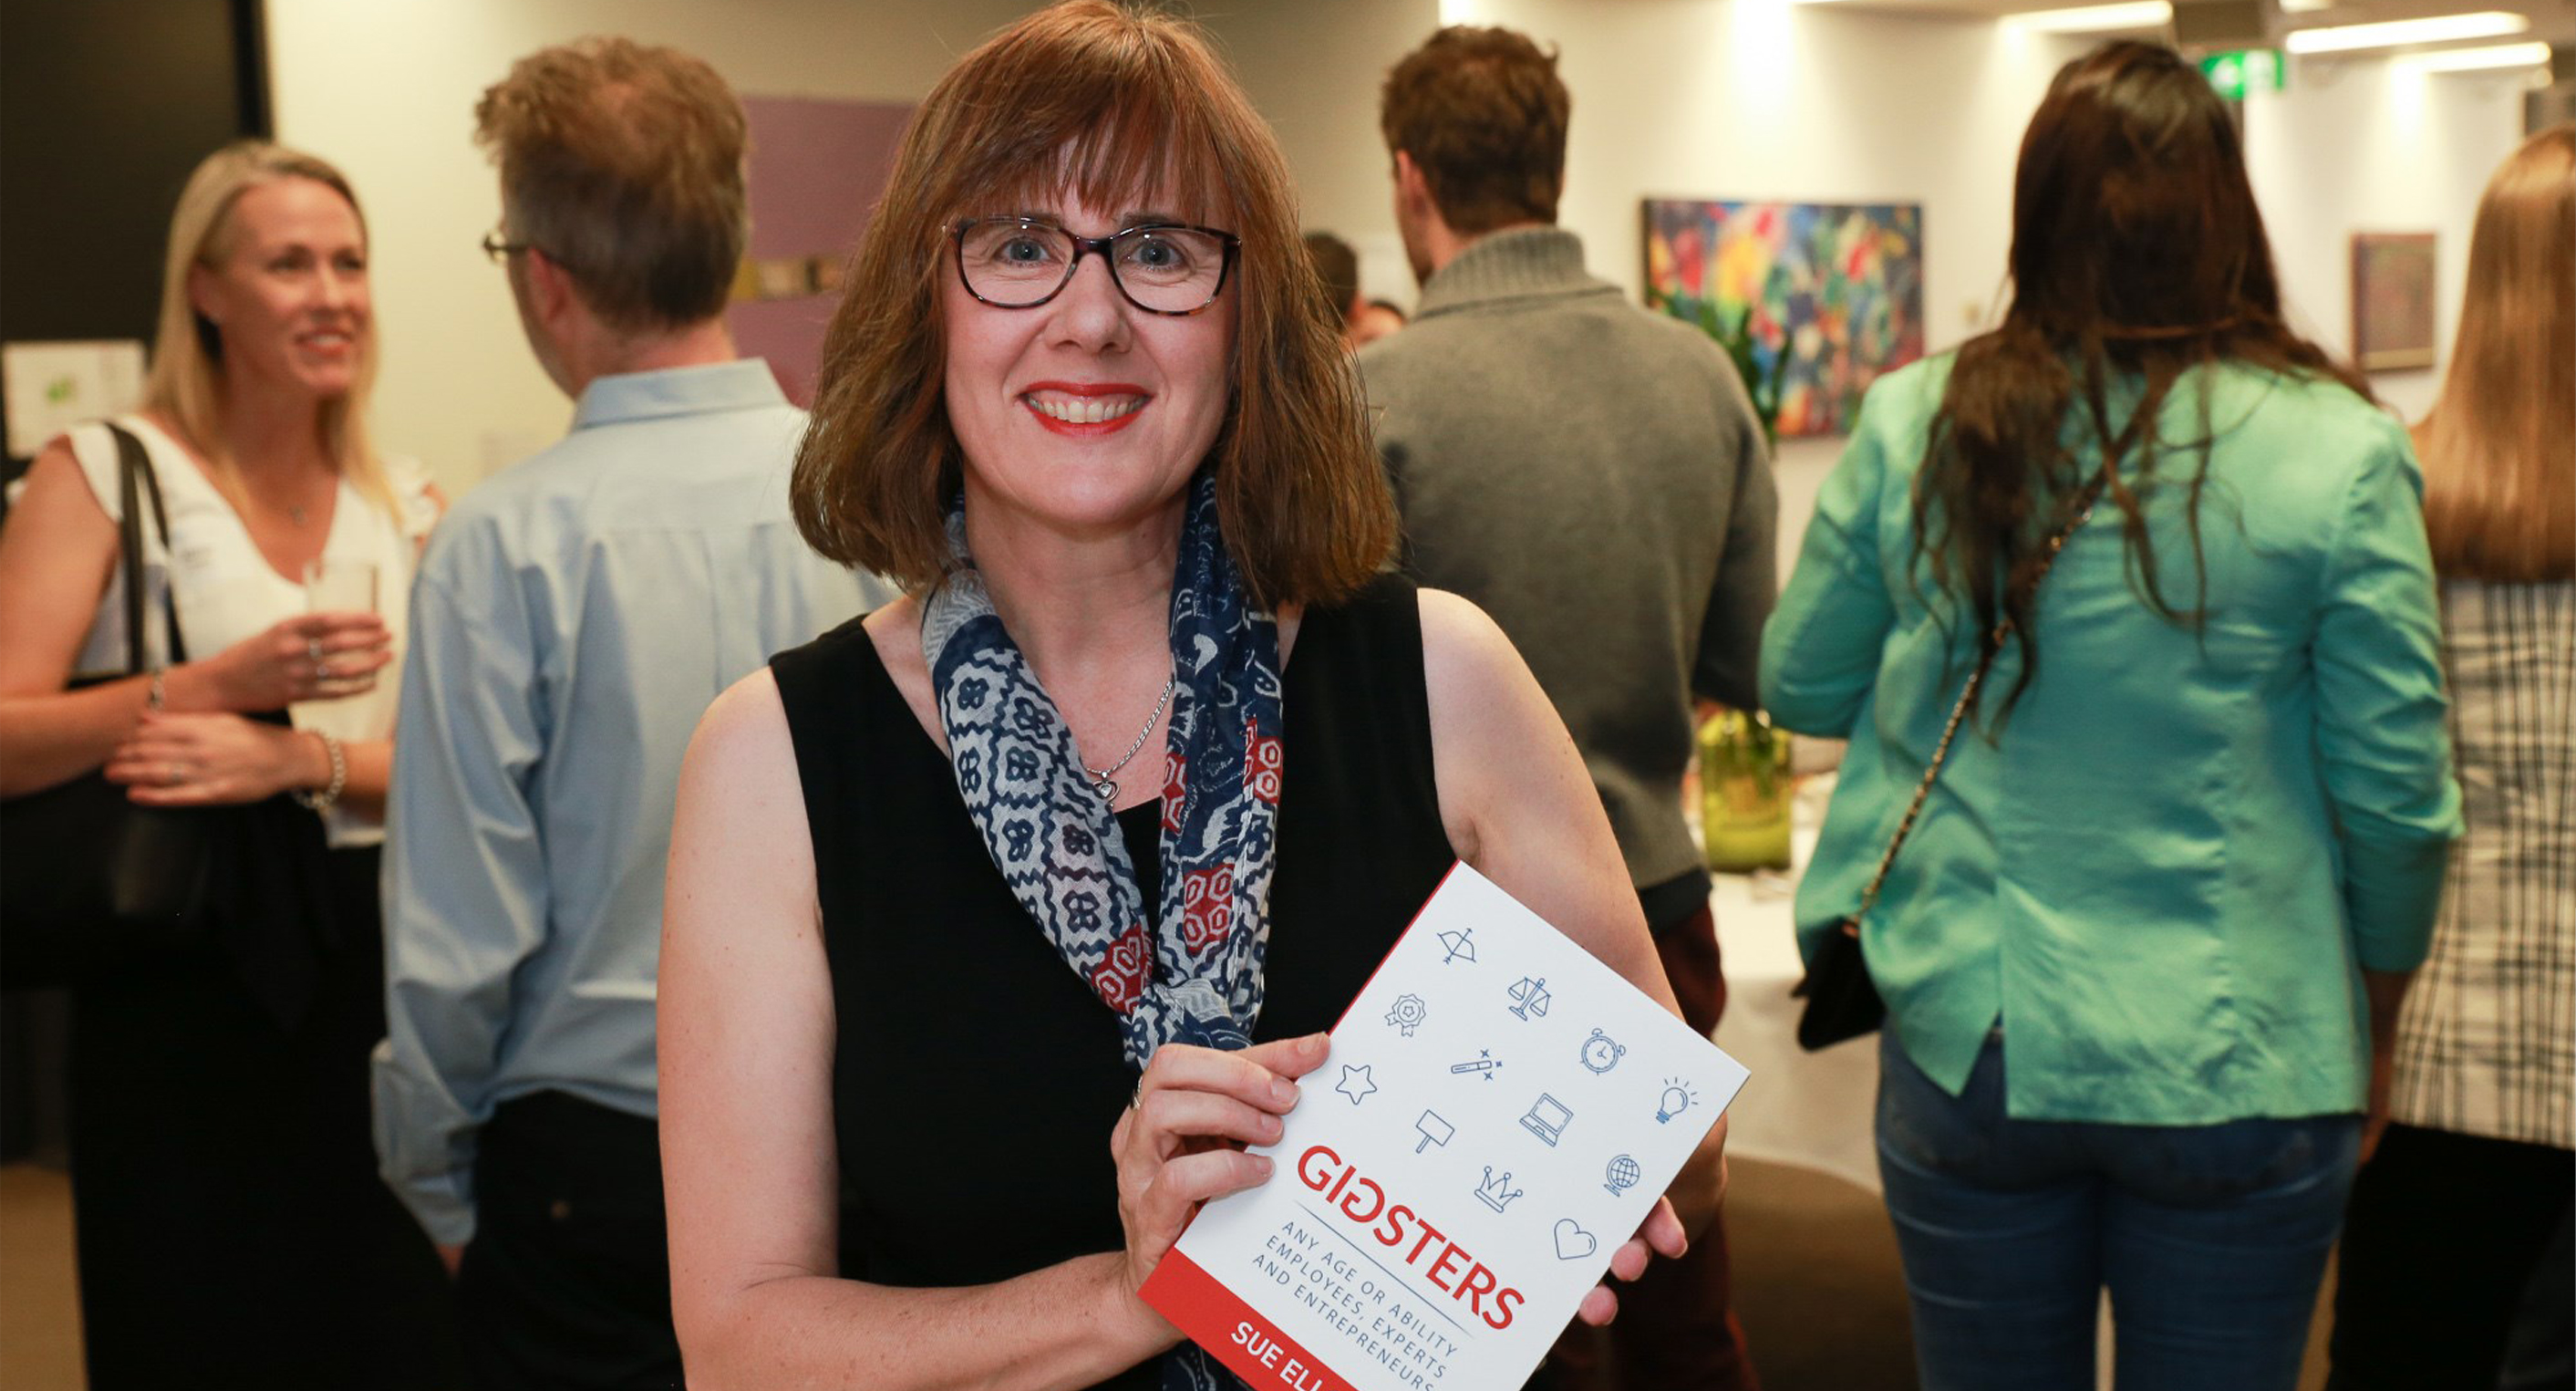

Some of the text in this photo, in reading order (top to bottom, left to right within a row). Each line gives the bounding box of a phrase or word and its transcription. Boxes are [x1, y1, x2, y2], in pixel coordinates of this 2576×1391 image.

[1253, 1255, 1289, 1284] AND
[1282, 1222, 1456, 1356] ANY AGE OR ABILITY
[1298, 1146, 1525, 1329] GIGSTERS
[1232, 1323, 1283, 1368] SUE
[1267, 1236, 1445, 1377] EMPLOYEES, EXPERTS
